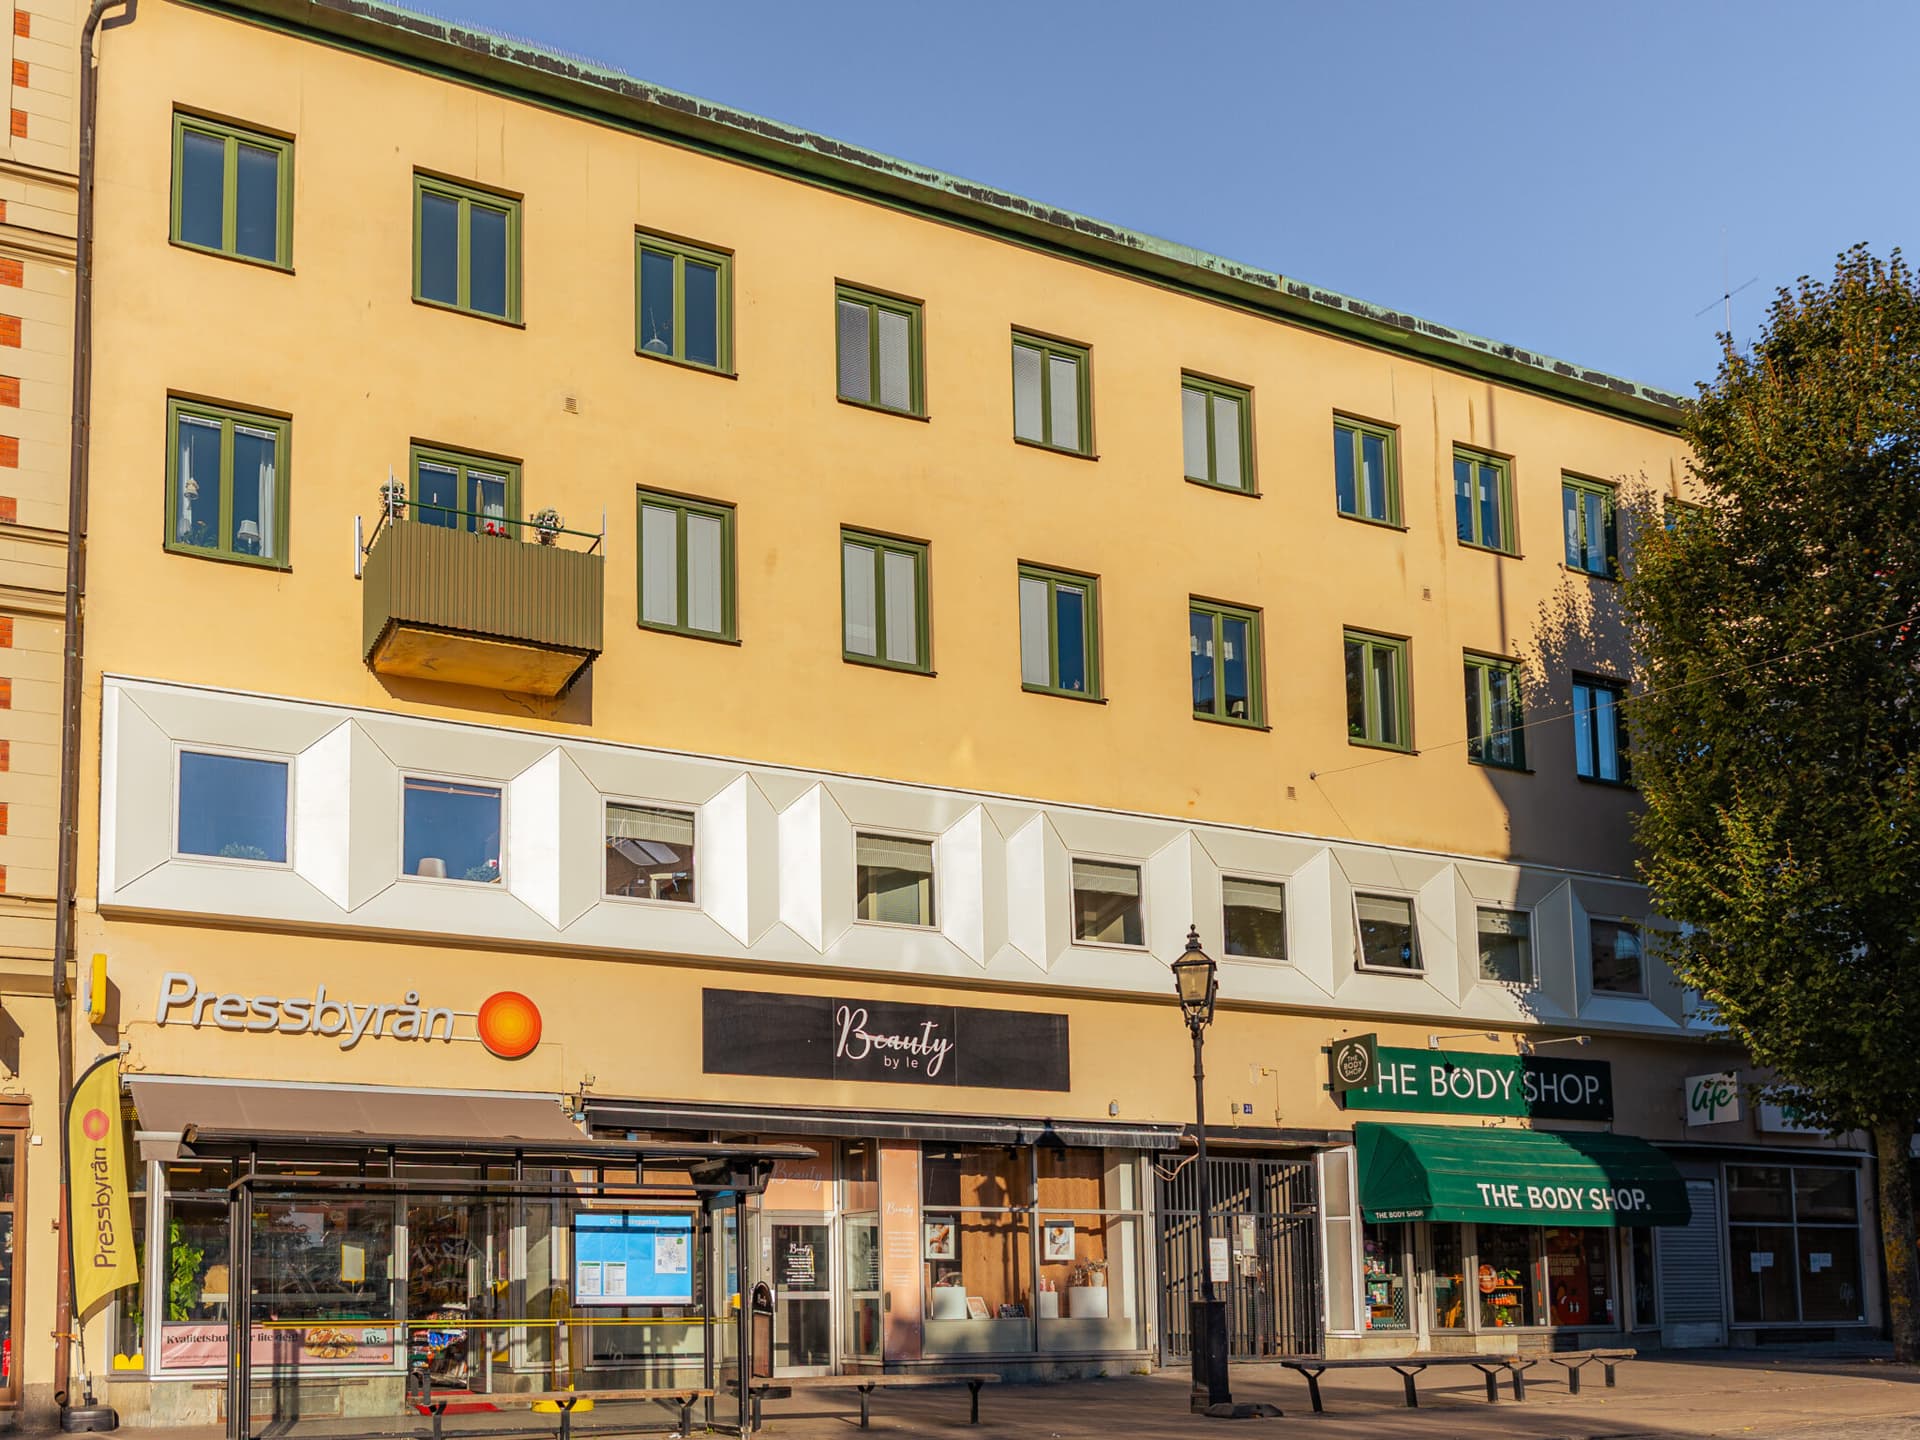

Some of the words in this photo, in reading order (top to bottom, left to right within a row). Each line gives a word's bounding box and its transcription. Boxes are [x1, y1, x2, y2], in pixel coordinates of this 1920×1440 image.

[156, 971, 455, 1051] Pressbyrån
[836, 1005, 954, 1077] Beauty
[884, 1055, 899, 1069] by
[1343, 1060, 1363, 1070] BODY
[1364, 1062, 1418, 1095] HE
[1431, 1065, 1515, 1100] BODY
[90, 1147, 116, 1269] Pressbyrån
[1476, 1183, 1522, 1208] THE
[1526, 1185, 1584, 1210] BODY
[1376, 1211, 1389, 1219] THE
